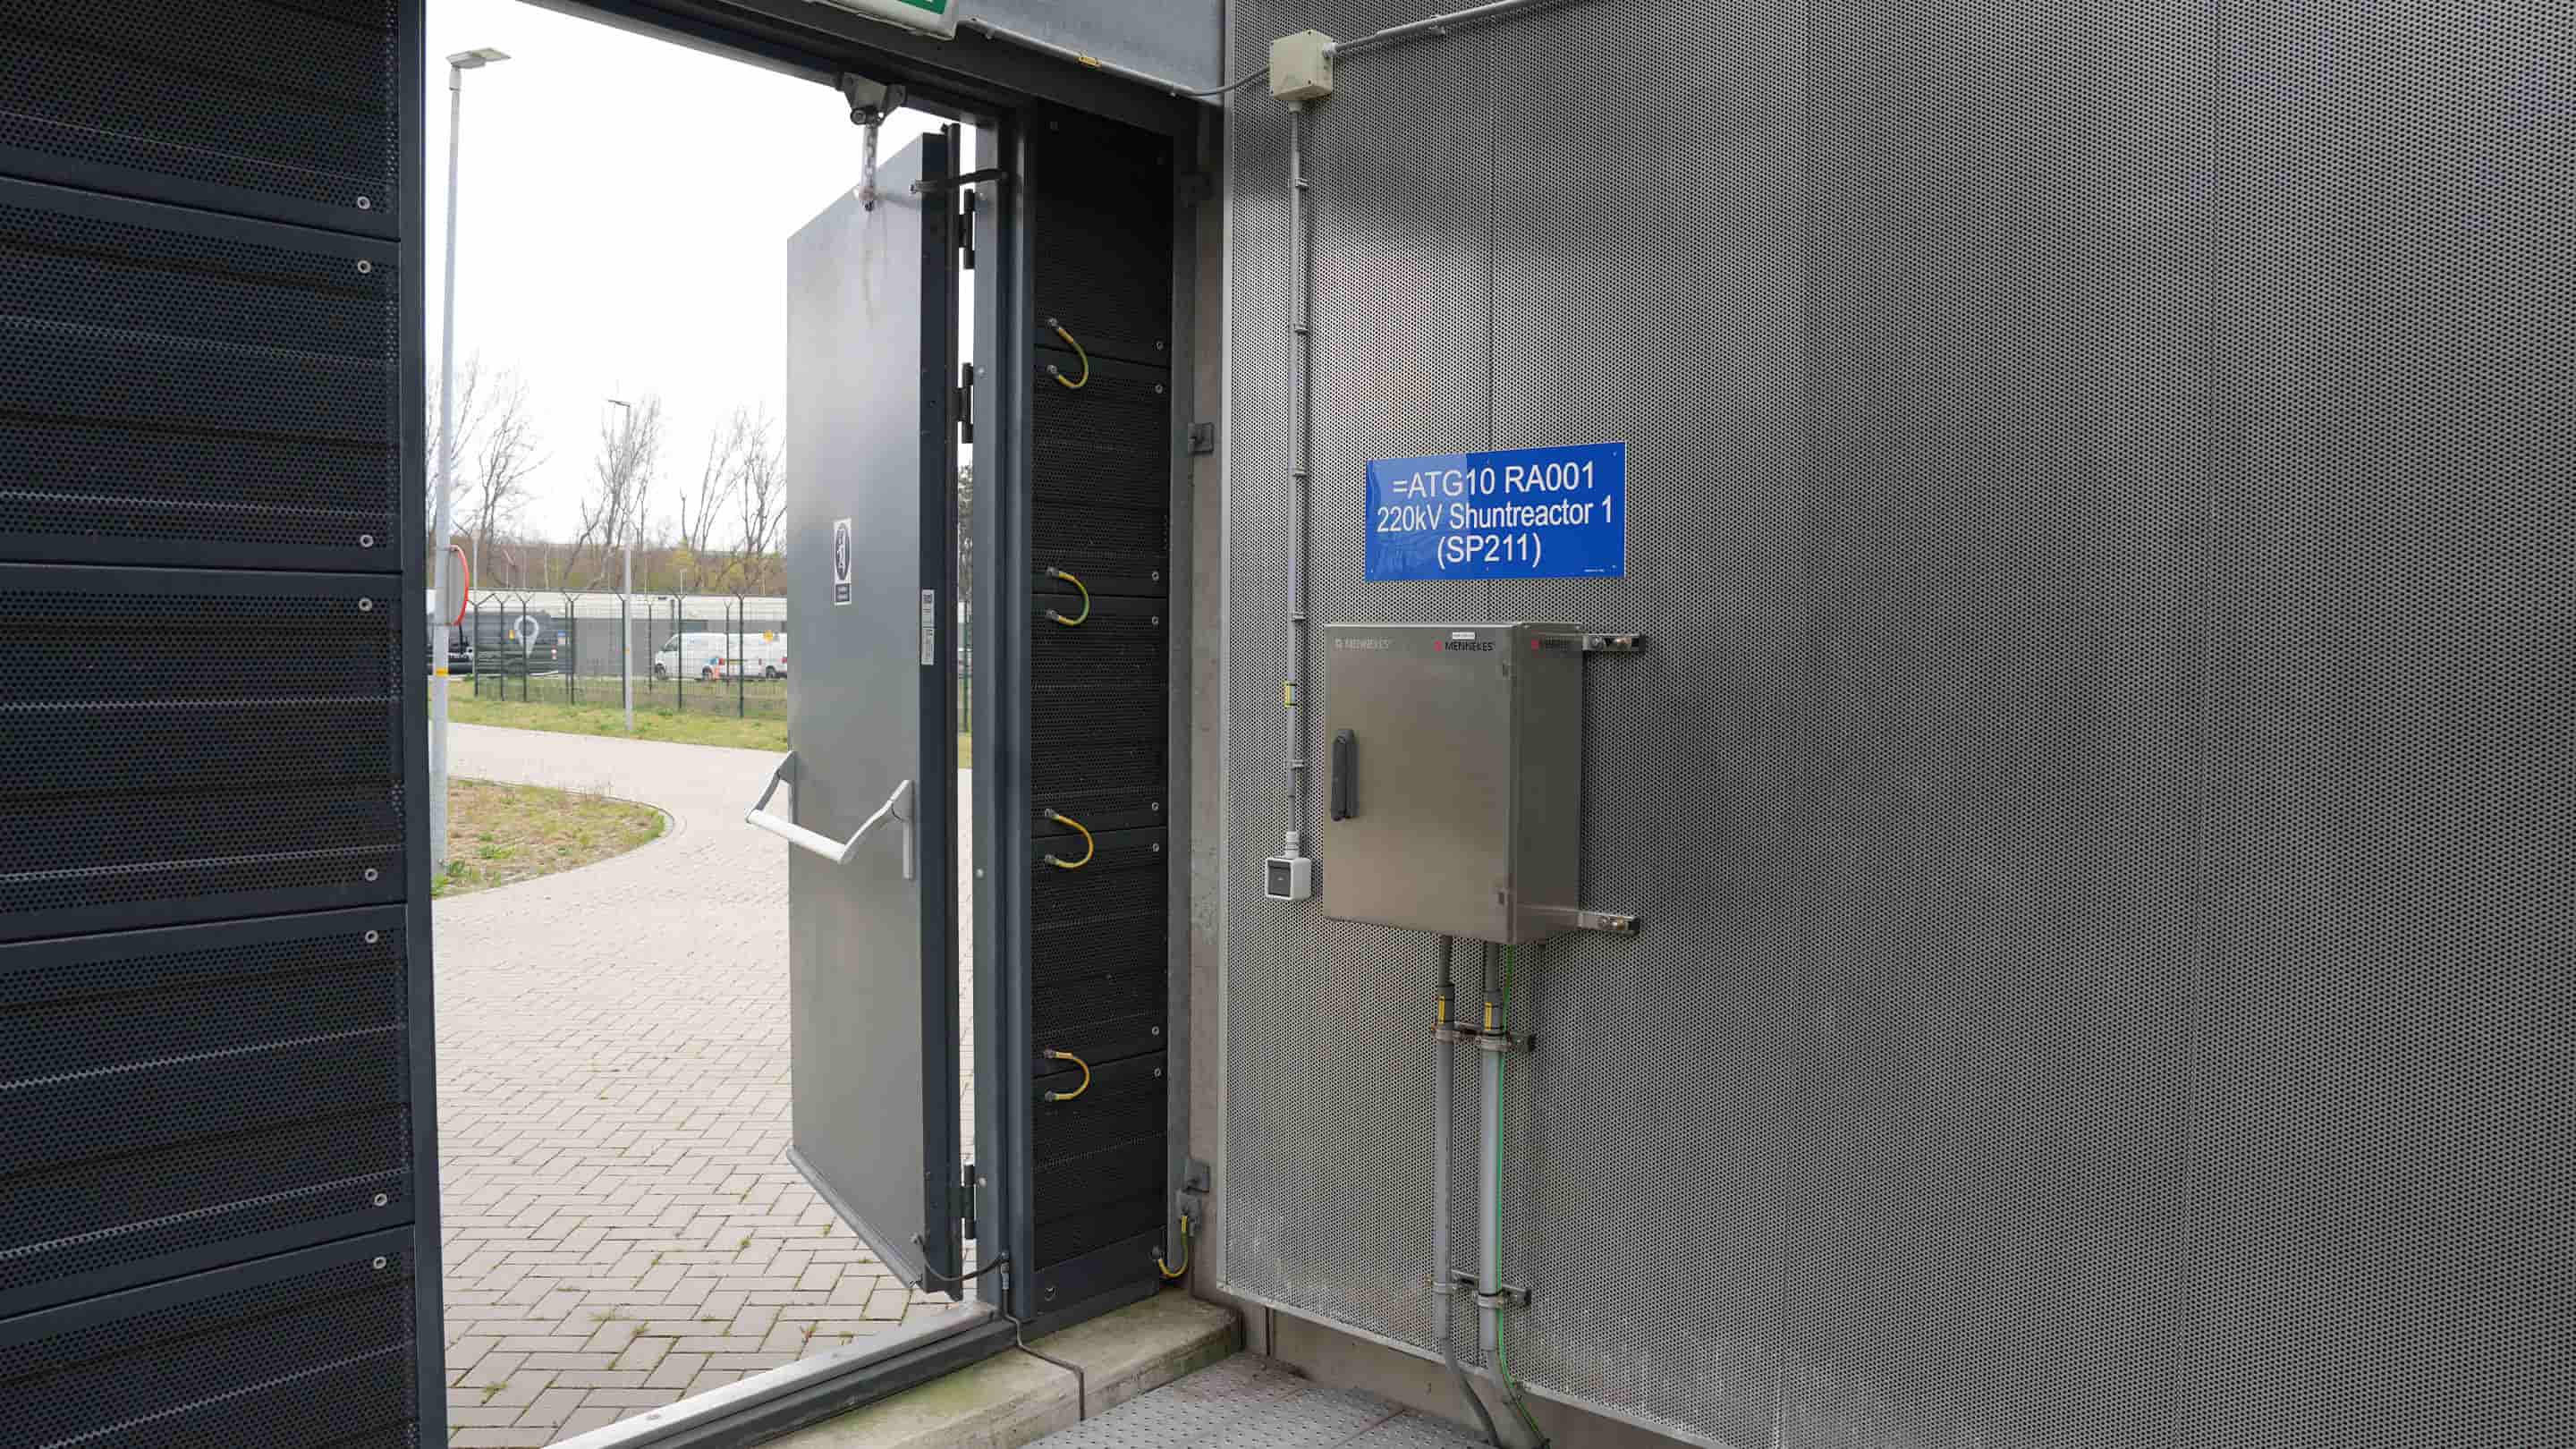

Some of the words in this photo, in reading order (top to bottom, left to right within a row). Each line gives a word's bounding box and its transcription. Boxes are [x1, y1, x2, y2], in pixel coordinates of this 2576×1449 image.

[1392, 467, 1496, 499] =ATG10
[1504, 460, 1595, 494] RA001
[1377, 504, 1443, 532] 220kV
[1449, 498, 1594, 530] Shuntreactor
[1601, 495, 1613, 523] 1
[1436, 532, 1542, 569] (SP211)
